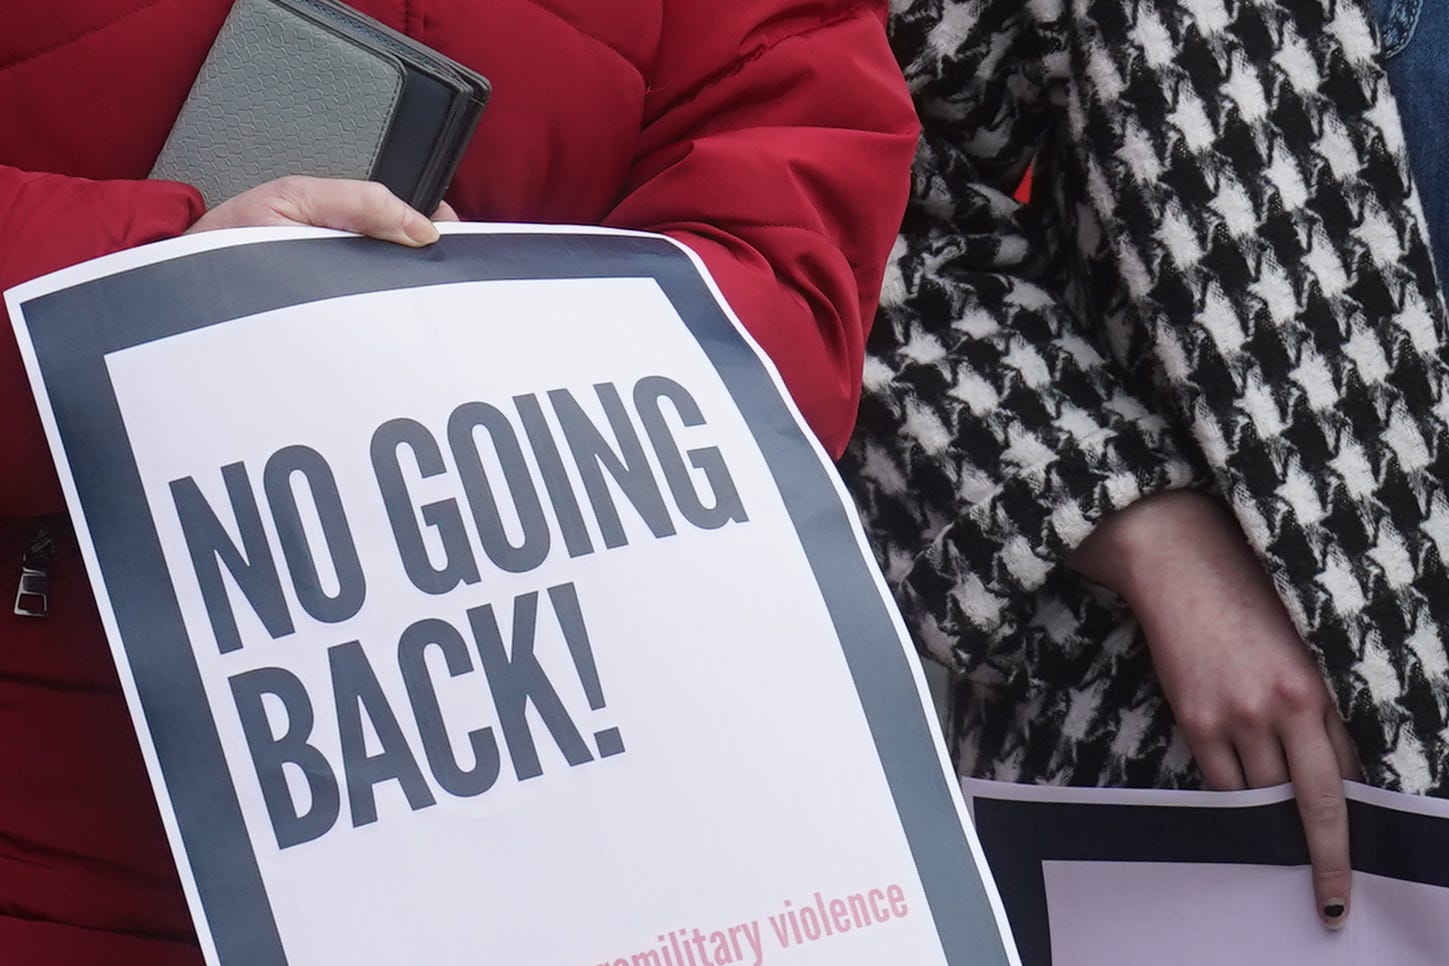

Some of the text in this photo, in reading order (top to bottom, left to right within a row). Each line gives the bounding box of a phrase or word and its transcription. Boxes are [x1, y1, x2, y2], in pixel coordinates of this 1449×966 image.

[168, 376, 749, 655] NO GOING
[227, 582, 627, 850] BACK!
[768, 883, 909, 949] violence
